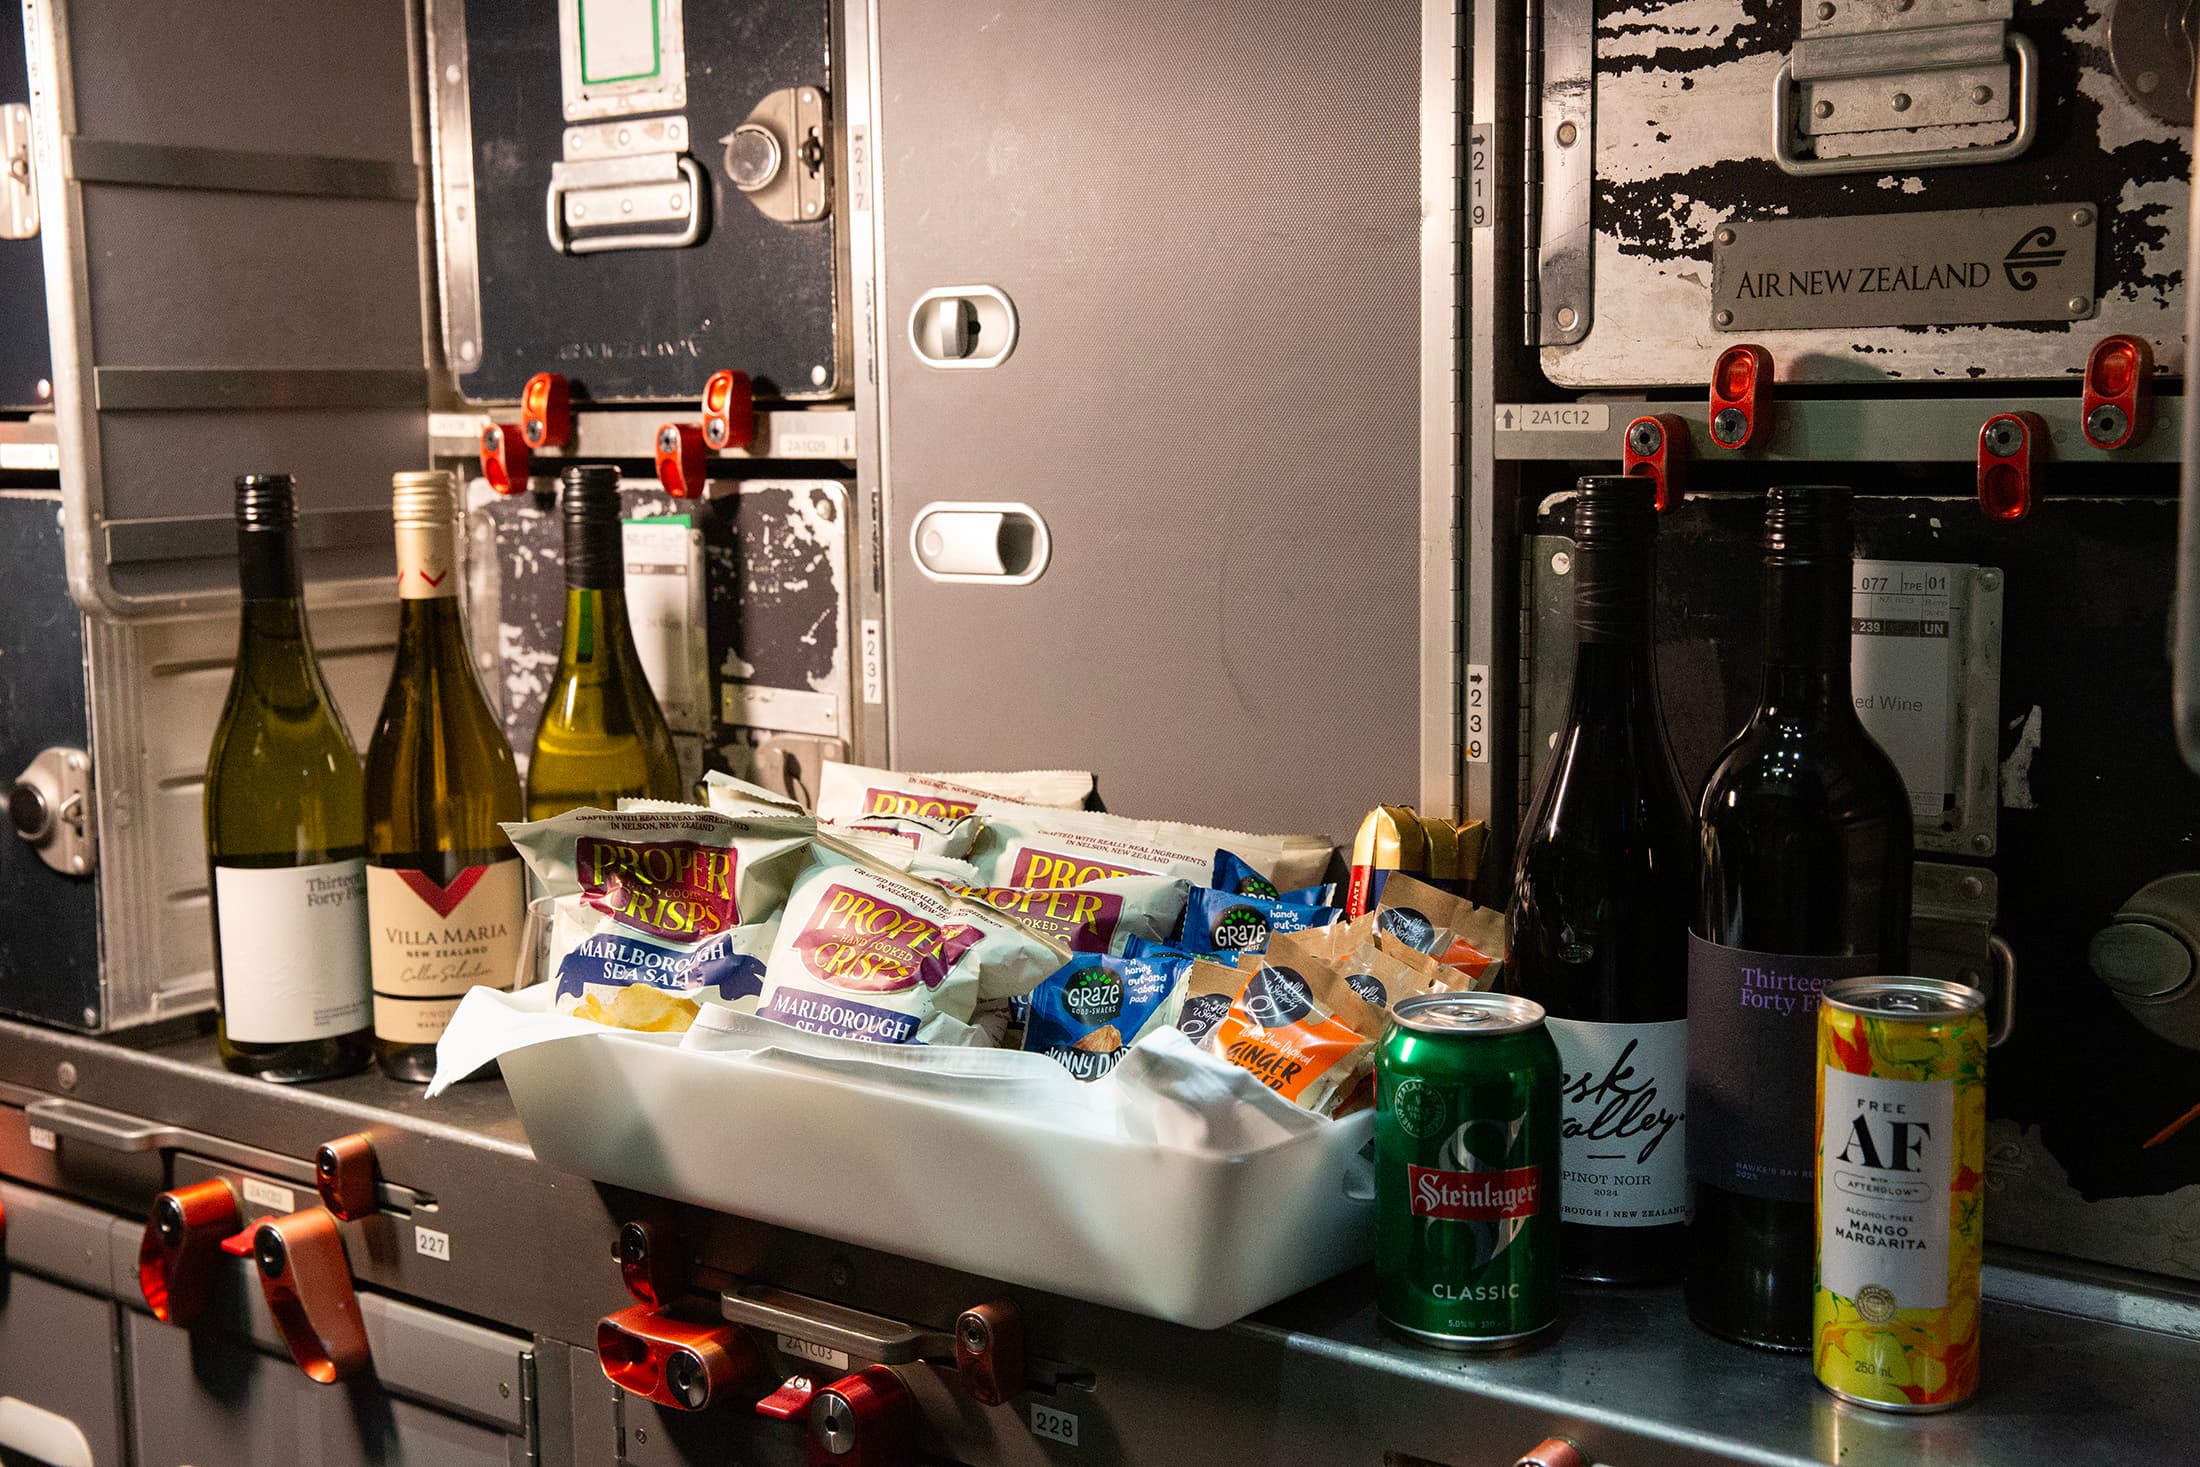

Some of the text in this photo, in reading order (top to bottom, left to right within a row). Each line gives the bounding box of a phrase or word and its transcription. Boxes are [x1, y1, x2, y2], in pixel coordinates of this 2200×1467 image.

[855, 147, 864, 209] 217
[1472, 151, 1485, 224] 219
[1736, 261, 1991, 299] AIR NEW ZEALAND
[1531, 410, 1590, 424] 2A1C12
[1861, 577, 1945, 591] 077 TPE 01
[1859, 621, 1944, 634] 239 UN
[867, 640, 876, 699] 237
[1855, 696, 1923, 712] ed Wine
[1470, 688, 1482, 759] 239
[611, 822, 715, 832] IN NELSON, NEW ZEALAND
[1038, 830, 1208, 867] CRAFTED WITH REALLY REAL INGREDIENTS
[1065, 839, 1170, 865] IN NELSON, NEW ZEALAND
[593, 843, 731, 900] PROPER
[1024, 854, 1130, 888] PRO
[307, 890, 343, 907] Forty
[854, 867, 888, 884] CRAFTED
[888, 880, 908, 893] WITH
[908, 889, 939, 908] REALLY
[609, 887, 720, 933] CRISPS
[884, 886, 917, 904] NELSON,
[917, 902, 937, 915] NEW
[1270, 909, 1299, 923] handy
[386, 924, 507, 945] VILLA MARIA
[840, 934, 867, 947] HAND
[436, 946, 489, 957] ZEALAND
[814, 943, 917, 982] CRISPS
[604, 962, 692, 987] SEA SALT
[1125, 965, 1153, 976] handy
[1128, 974, 1167, 986] out-and
[1130, 995, 1148, 1005] pack
[1741, 988, 1797, 1017] Forty
[774, 994, 912, 1041] MARLBOROUGH
[1045, 1046, 1094, 1079] KINNY
[1226, 1041, 1302, 1084] GINGER
[1857, 1098, 1906, 1115] FREE
[1836, 1114, 1931, 1173] AF
[1561, 1171, 1652, 1186] PINOT NOIR
[1414, 1173, 1537, 1212] Steinlager
[1594, 1188, 1618, 1198] 2024
[1613, 1209, 1637, 1218] NEW
[1642, 1206, 1686, 1217] ZEALAND
[1846, 1206, 1914, 1223] ALCOHOL FREE
[1835, 1227, 1927, 1250] MARGARITA
[1850, 1219, 1909, 1238] MANGO
[419, 1234, 445, 1254] 227
[1432, 1283, 1520, 1300] CLASSIC
[1855, 1361, 1875, 1375] 250
[1036, 1412, 1073, 1438] 228
